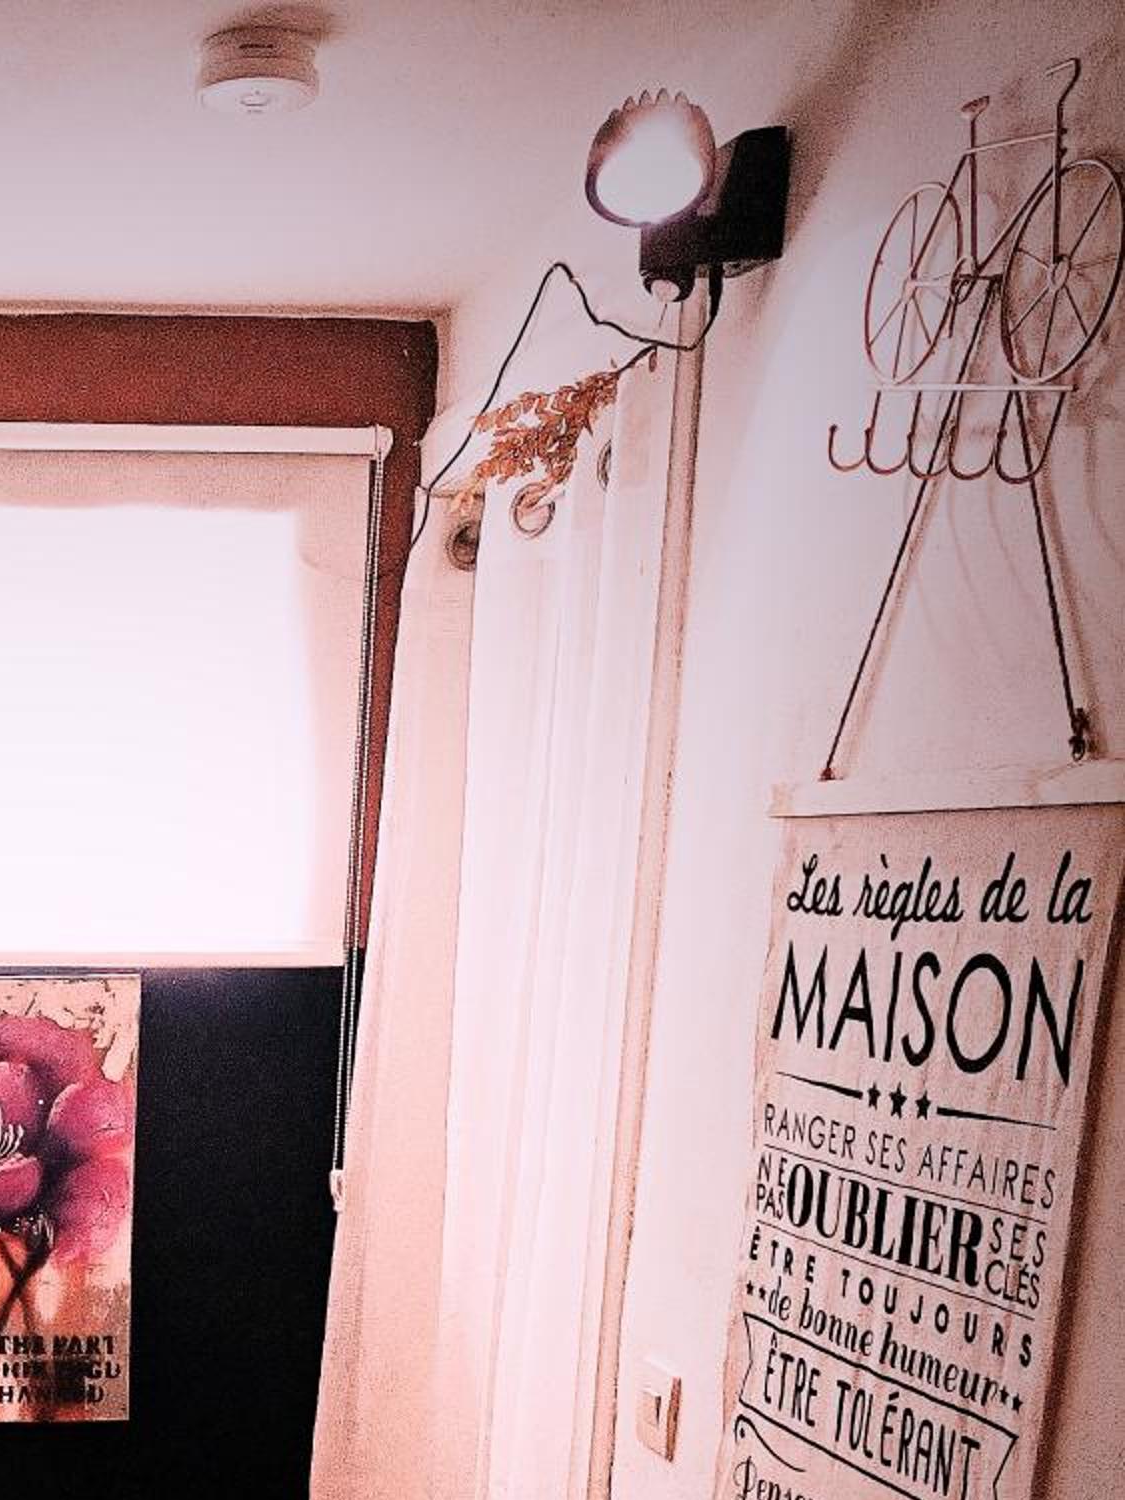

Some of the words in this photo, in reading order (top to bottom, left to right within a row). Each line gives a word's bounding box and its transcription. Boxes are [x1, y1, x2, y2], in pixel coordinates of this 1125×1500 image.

[786, 853, 843, 916] Les
[853, 853, 963, 941] règles
[980, 852, 1030, 923] de
[1047, 850, 1093, 924] la
[771, 940, 1084, 1086] MAISON
[757, 1154, 787, 1188] NE
[757, 1184, 785, 1220] PAS
[764, 1103, 856, 1160] RANGER
[865, 1130, 907, 1172] SES
[918, 1144, 1056, 1210] AFFAIRES
[786, 1163, 983, 1287] OUBLIER
[989, 1217, 1046, 1268] SES
[749, 1226, 816, 1283] ÊTRE
[842, 1269, 1032, 1368] TOUJOURS
[985, 1259, 1041, 1309] CLÉS
[764, 1332, 821, 1428] ÊTRE
[768, 1276, 792, 1322] de
[799, 1287, 874, 1357] bonne
[879, 1322, 998, 1408] humeur
